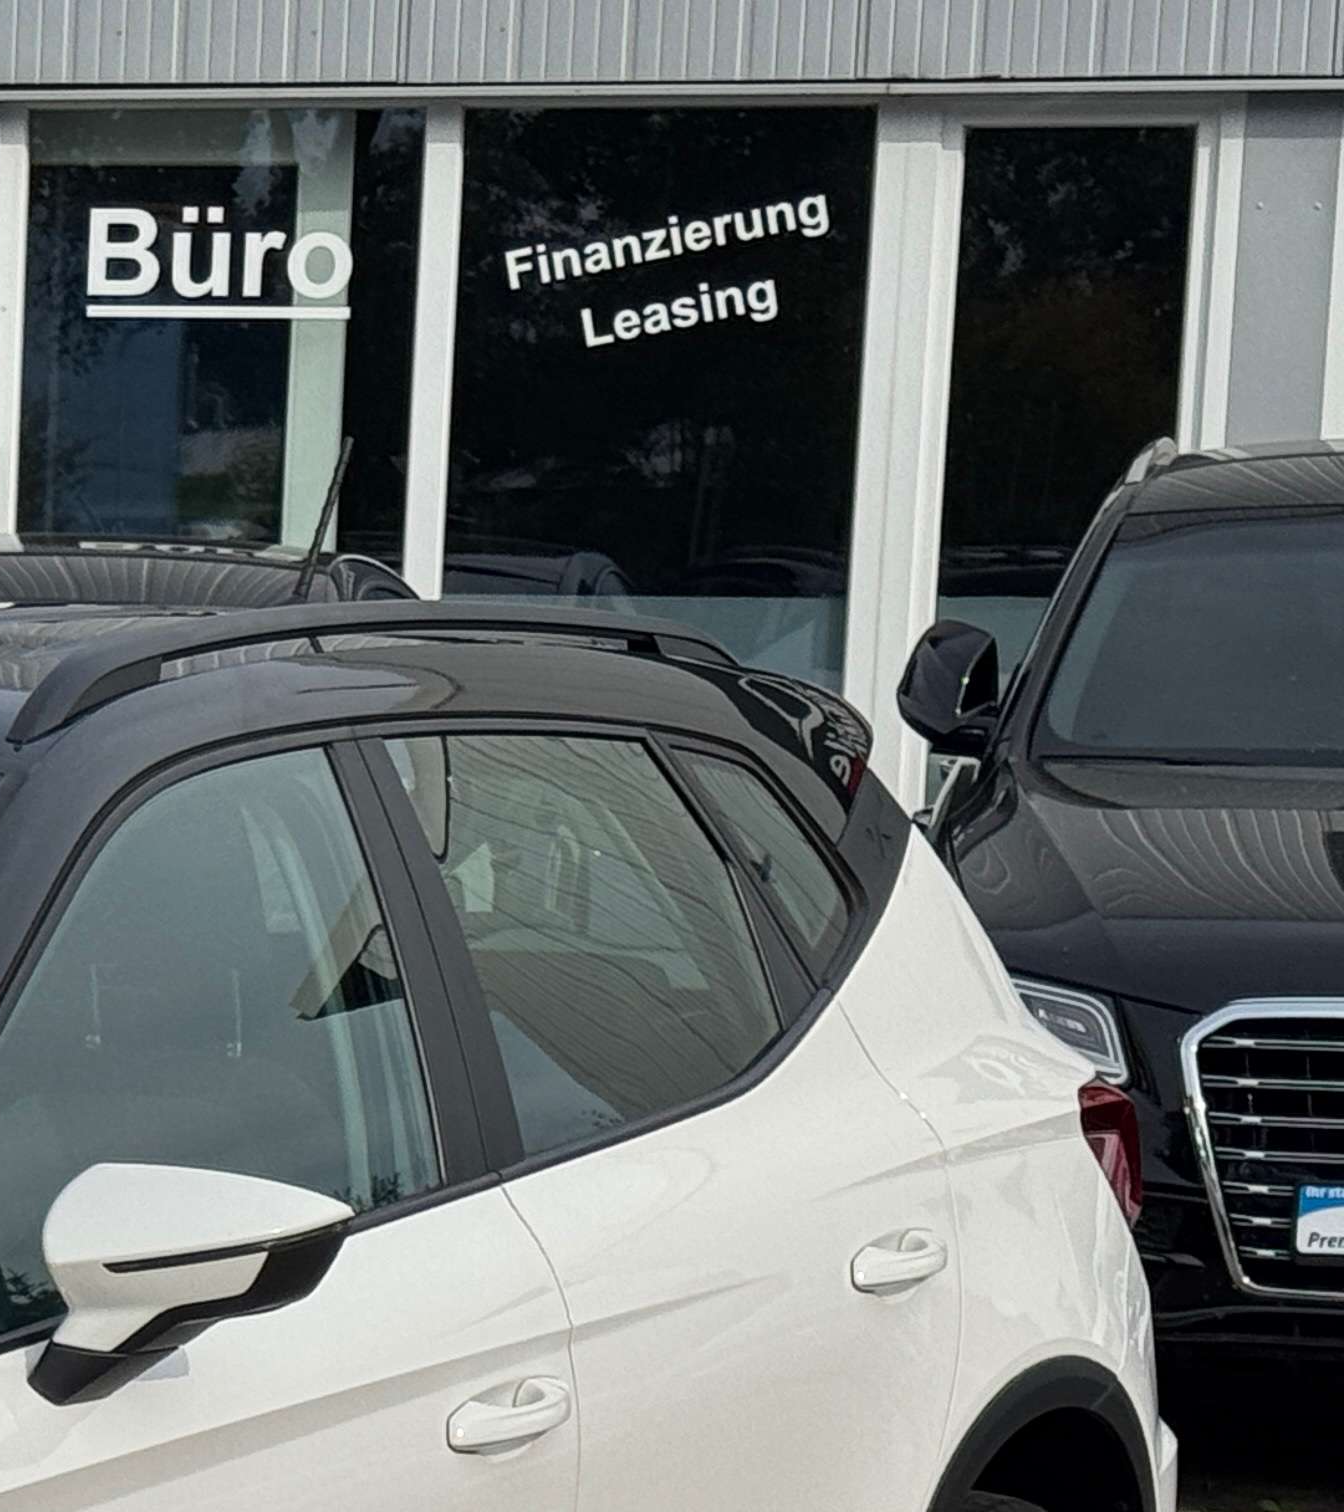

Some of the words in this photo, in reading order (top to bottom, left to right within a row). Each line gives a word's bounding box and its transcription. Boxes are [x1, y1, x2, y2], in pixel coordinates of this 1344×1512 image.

[86, 204, 355, 302] Büro
[504, 195, 830, 291] Finanzierung
[579, 274, 779, 348] Leasing
